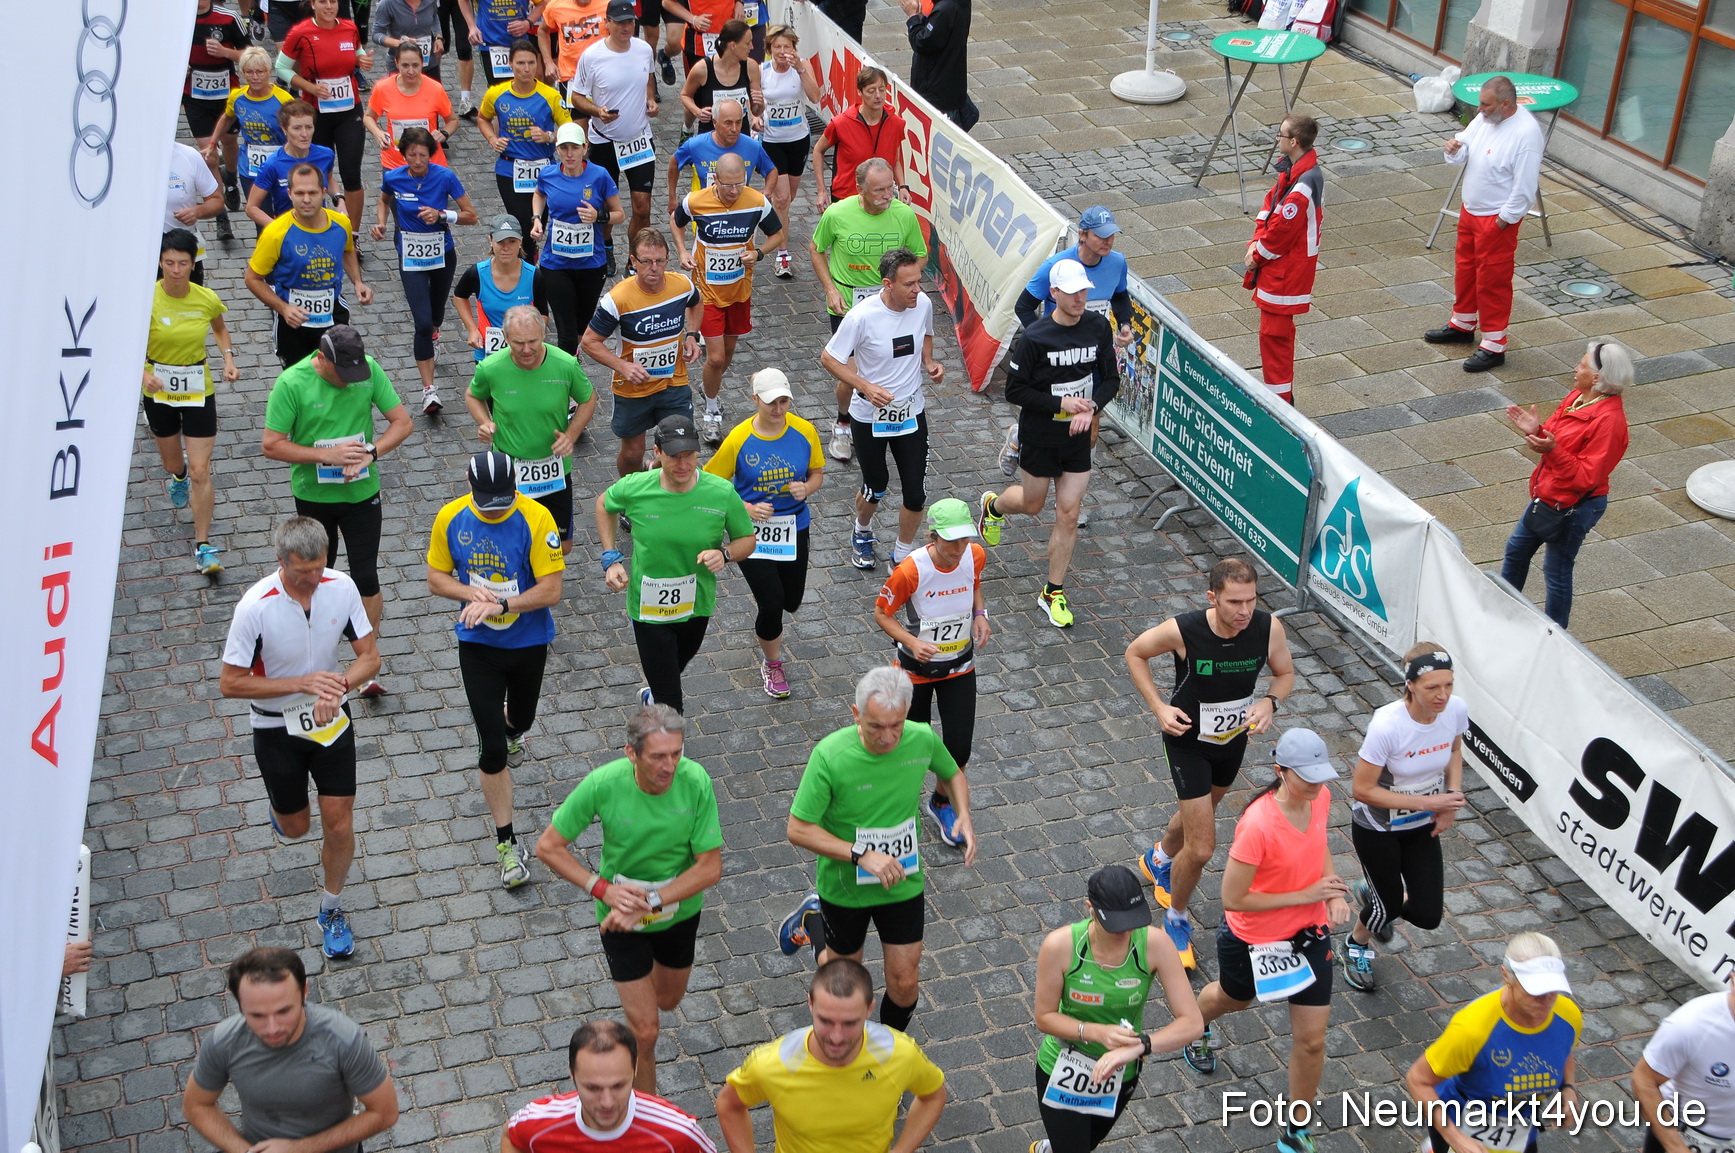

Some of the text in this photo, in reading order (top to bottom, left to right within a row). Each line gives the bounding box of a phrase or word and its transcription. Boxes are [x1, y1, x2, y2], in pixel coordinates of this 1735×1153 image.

[196, 77, 227, 90] 2734
[329, 84, 350, 100] 407
[770, 105, 799, 119] 2277
[618, 137, 648, 157] 2109
[517, 167, 540, 180] 210
[931, 131, 1038, 258] Egner
[556, 229, 590, 245] 2412
[712, 225, 750, 236] Fischer
[406, 242, 441, 258] 2325
[846, 232, 900, 254] OPF
[709, 256, 743, 272] 2324
[644, 315, 683, 332] Fischer
[649, 322, 681, 336] AUTOMOBILE
[490, 337, 509, 352] 24
[638, 350, 676, 368] 2786
[1046, 346, 1097, 367] THULE
[169, 376, 190, 392] 91
[166, 394, 192, 402] Brigitte
[1184, 360, 1253, 427] Event-Leit-Systeme
[877, 404, 911, 425] 2661
[1162, 382, 1254, 478] Mehr Sicherheit
[1160, 407, 1236, 490] für Ihr Event!
[519, 461, 560, 482] 2699
[528, 483, 555, 493] Andreas
[1157, 443, 1267, 553] Miet & Service Line: 09181 6352
[32, 296, 97, 768] Audi BKK
[752, 526, 791, 543] 2881
[758, 545, 784, 555] Sabrina
[661, 580, 689, 588] Neumarkt
[937, 586, 969, 597] KLEBL
[658, 588, 681, 605] 28
[1312, 573, 1341, 603] Gebäude
[1341, 597, 1366, 621] Service
[1366, 614, 1388, 638] GmbH
[931, 623, 963, 642] 127
[1215, 657, 1258, 668] rettenmeier
[1201, 706, 1222, 714] PARTL
[1473, 736, 1524, 791] verbinden
[857, 832, 879, 840] PARTL
[1556, 810, 1709, 957] stadtwerke
[1071, 991, 1102, 1003] OBI
[1060, 1053, 1084, 1069] PARTL
[1058, 1093, 1103, 1106] Katharina
[1470, 1125, 1518, 1147] 241
